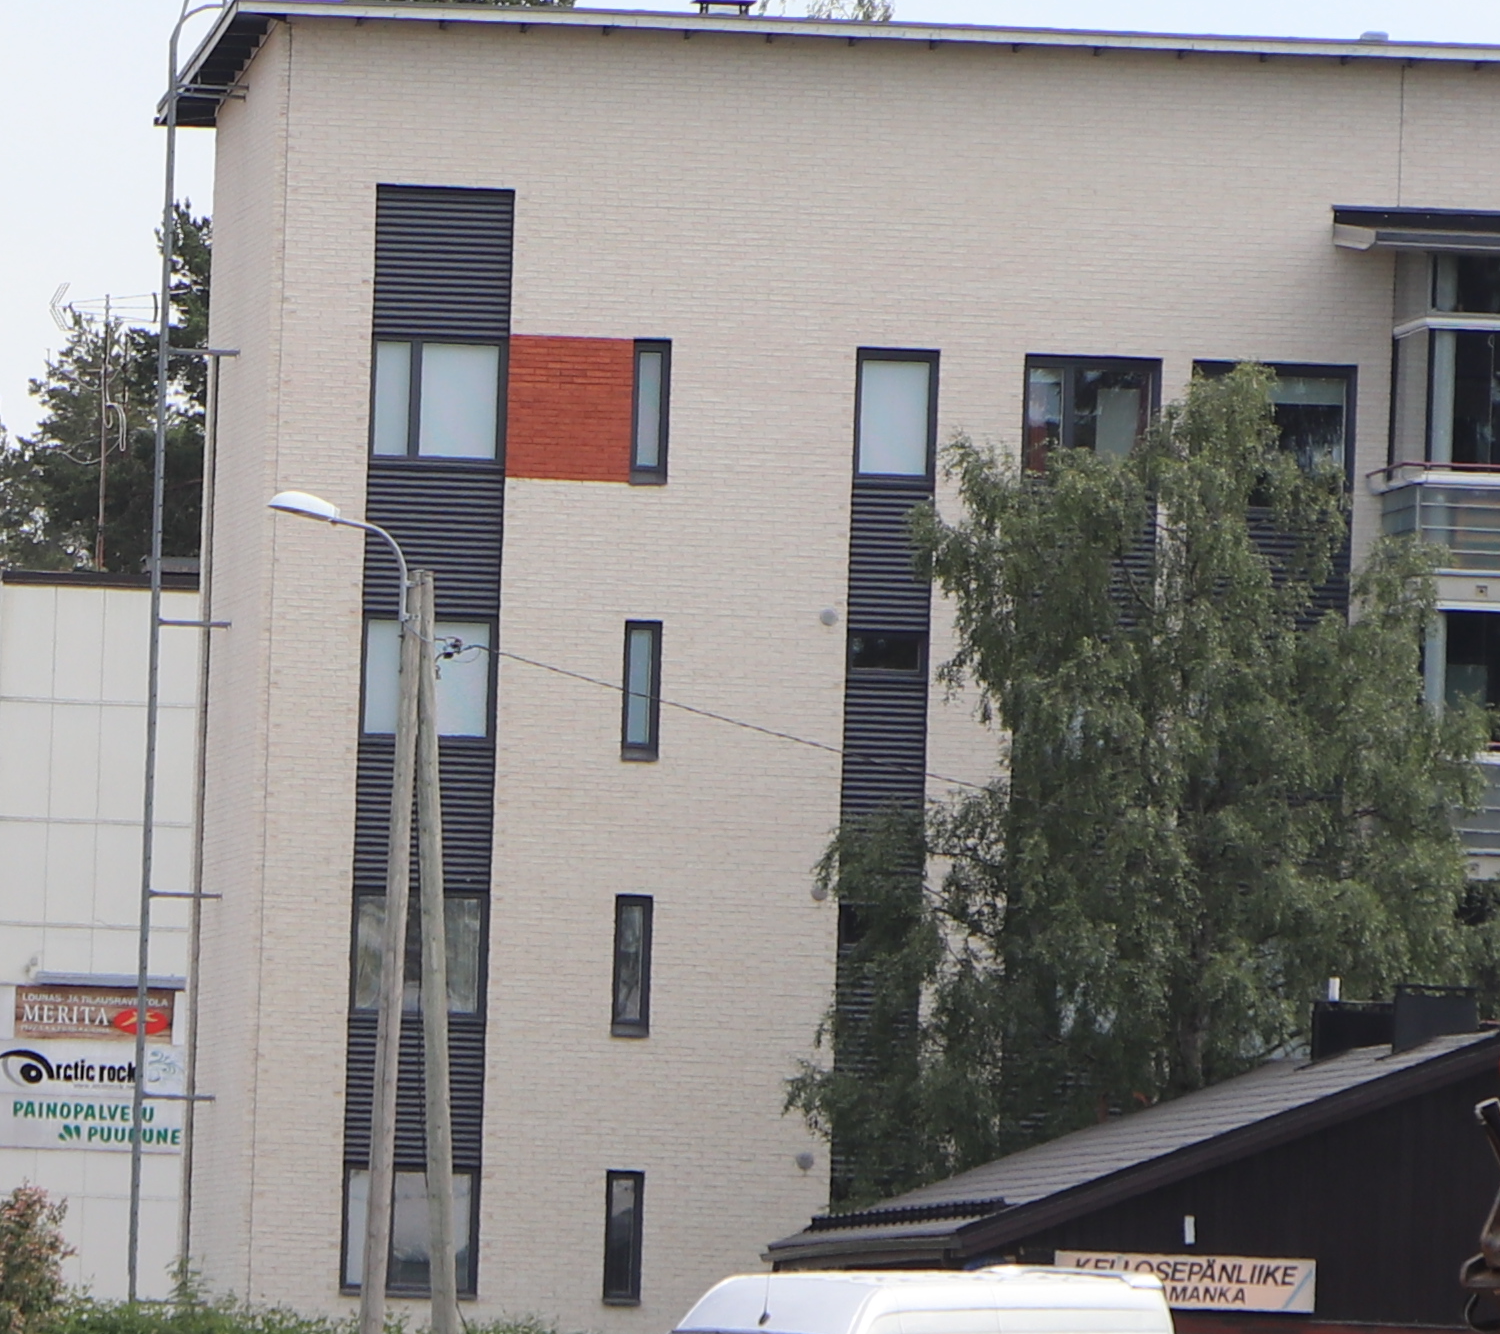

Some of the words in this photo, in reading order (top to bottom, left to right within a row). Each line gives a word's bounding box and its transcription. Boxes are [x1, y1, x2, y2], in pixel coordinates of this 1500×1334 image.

[22, 992, 64, 1004] LOUNAS-
[67, 994, 79, 1004] JA
[81, 995, 168, 1007] TILAUSRAVIOLA
[22, 1003, 109, 1026] MERITA
[12, 1100, 155, 1123] PAINOPALVEU
